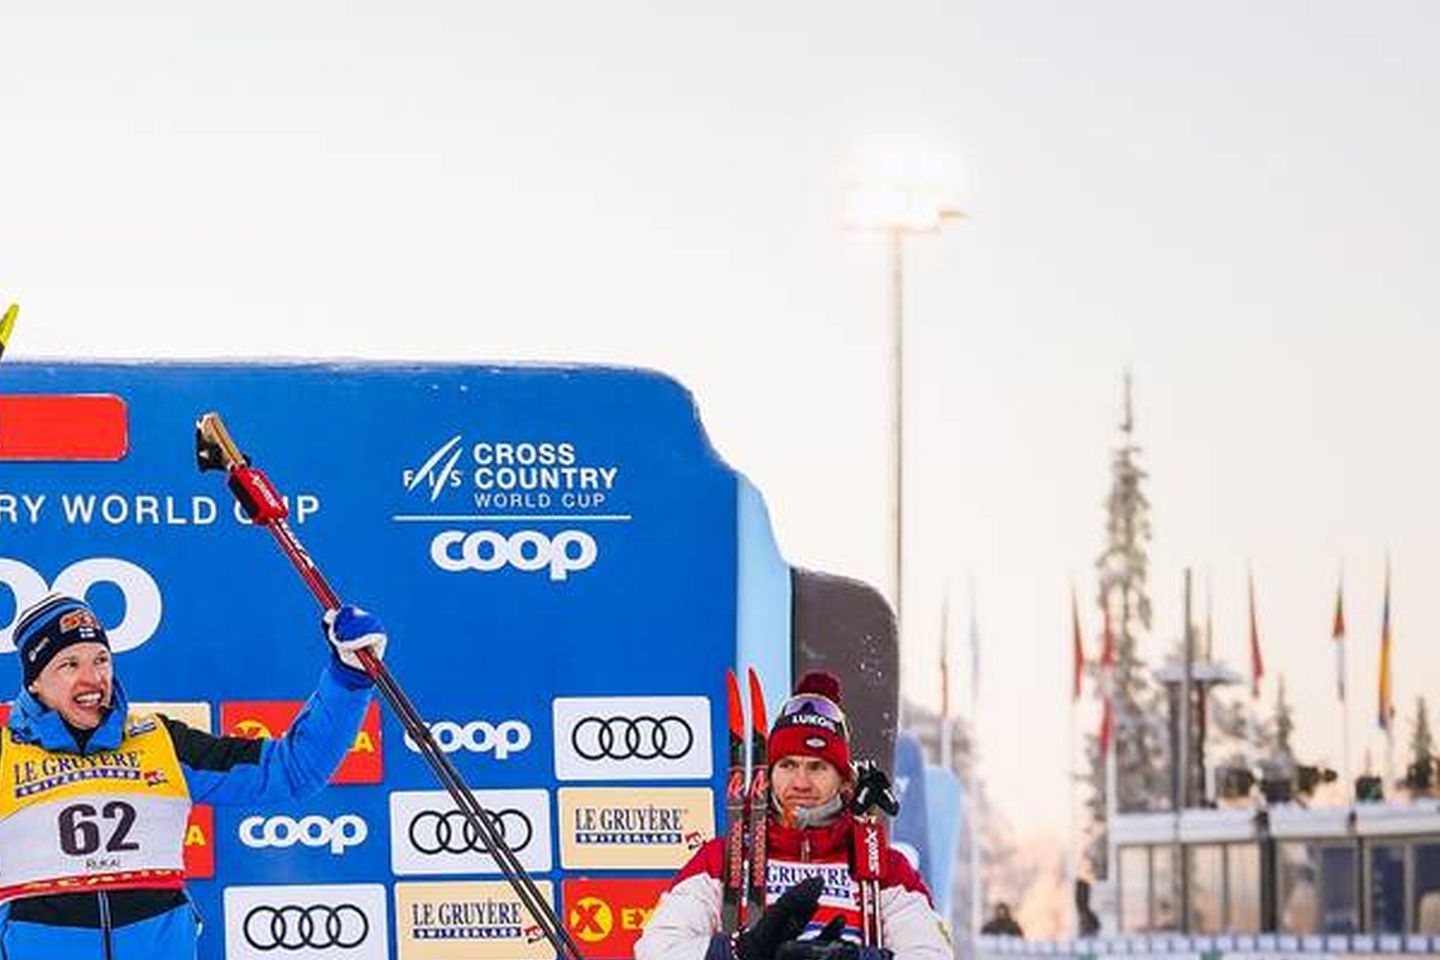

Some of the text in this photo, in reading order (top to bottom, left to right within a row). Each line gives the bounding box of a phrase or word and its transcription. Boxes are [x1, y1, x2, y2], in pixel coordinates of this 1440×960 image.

[474, 443, 575, 464] CROSS
[474, 468, 617, 489] COUNTRY
[63, 495, 217, 524] WORLD
[474, 493, 605, 508] WORLD CUP
[430, 530, 597, 579] coop
[58, 801, 140, 855] 62
[575, 804, 683, 831] LE GRUYÈRE
[238, 815, 368, 853] coop
[413, 899, 522, 926] LE GRUYÈRE
